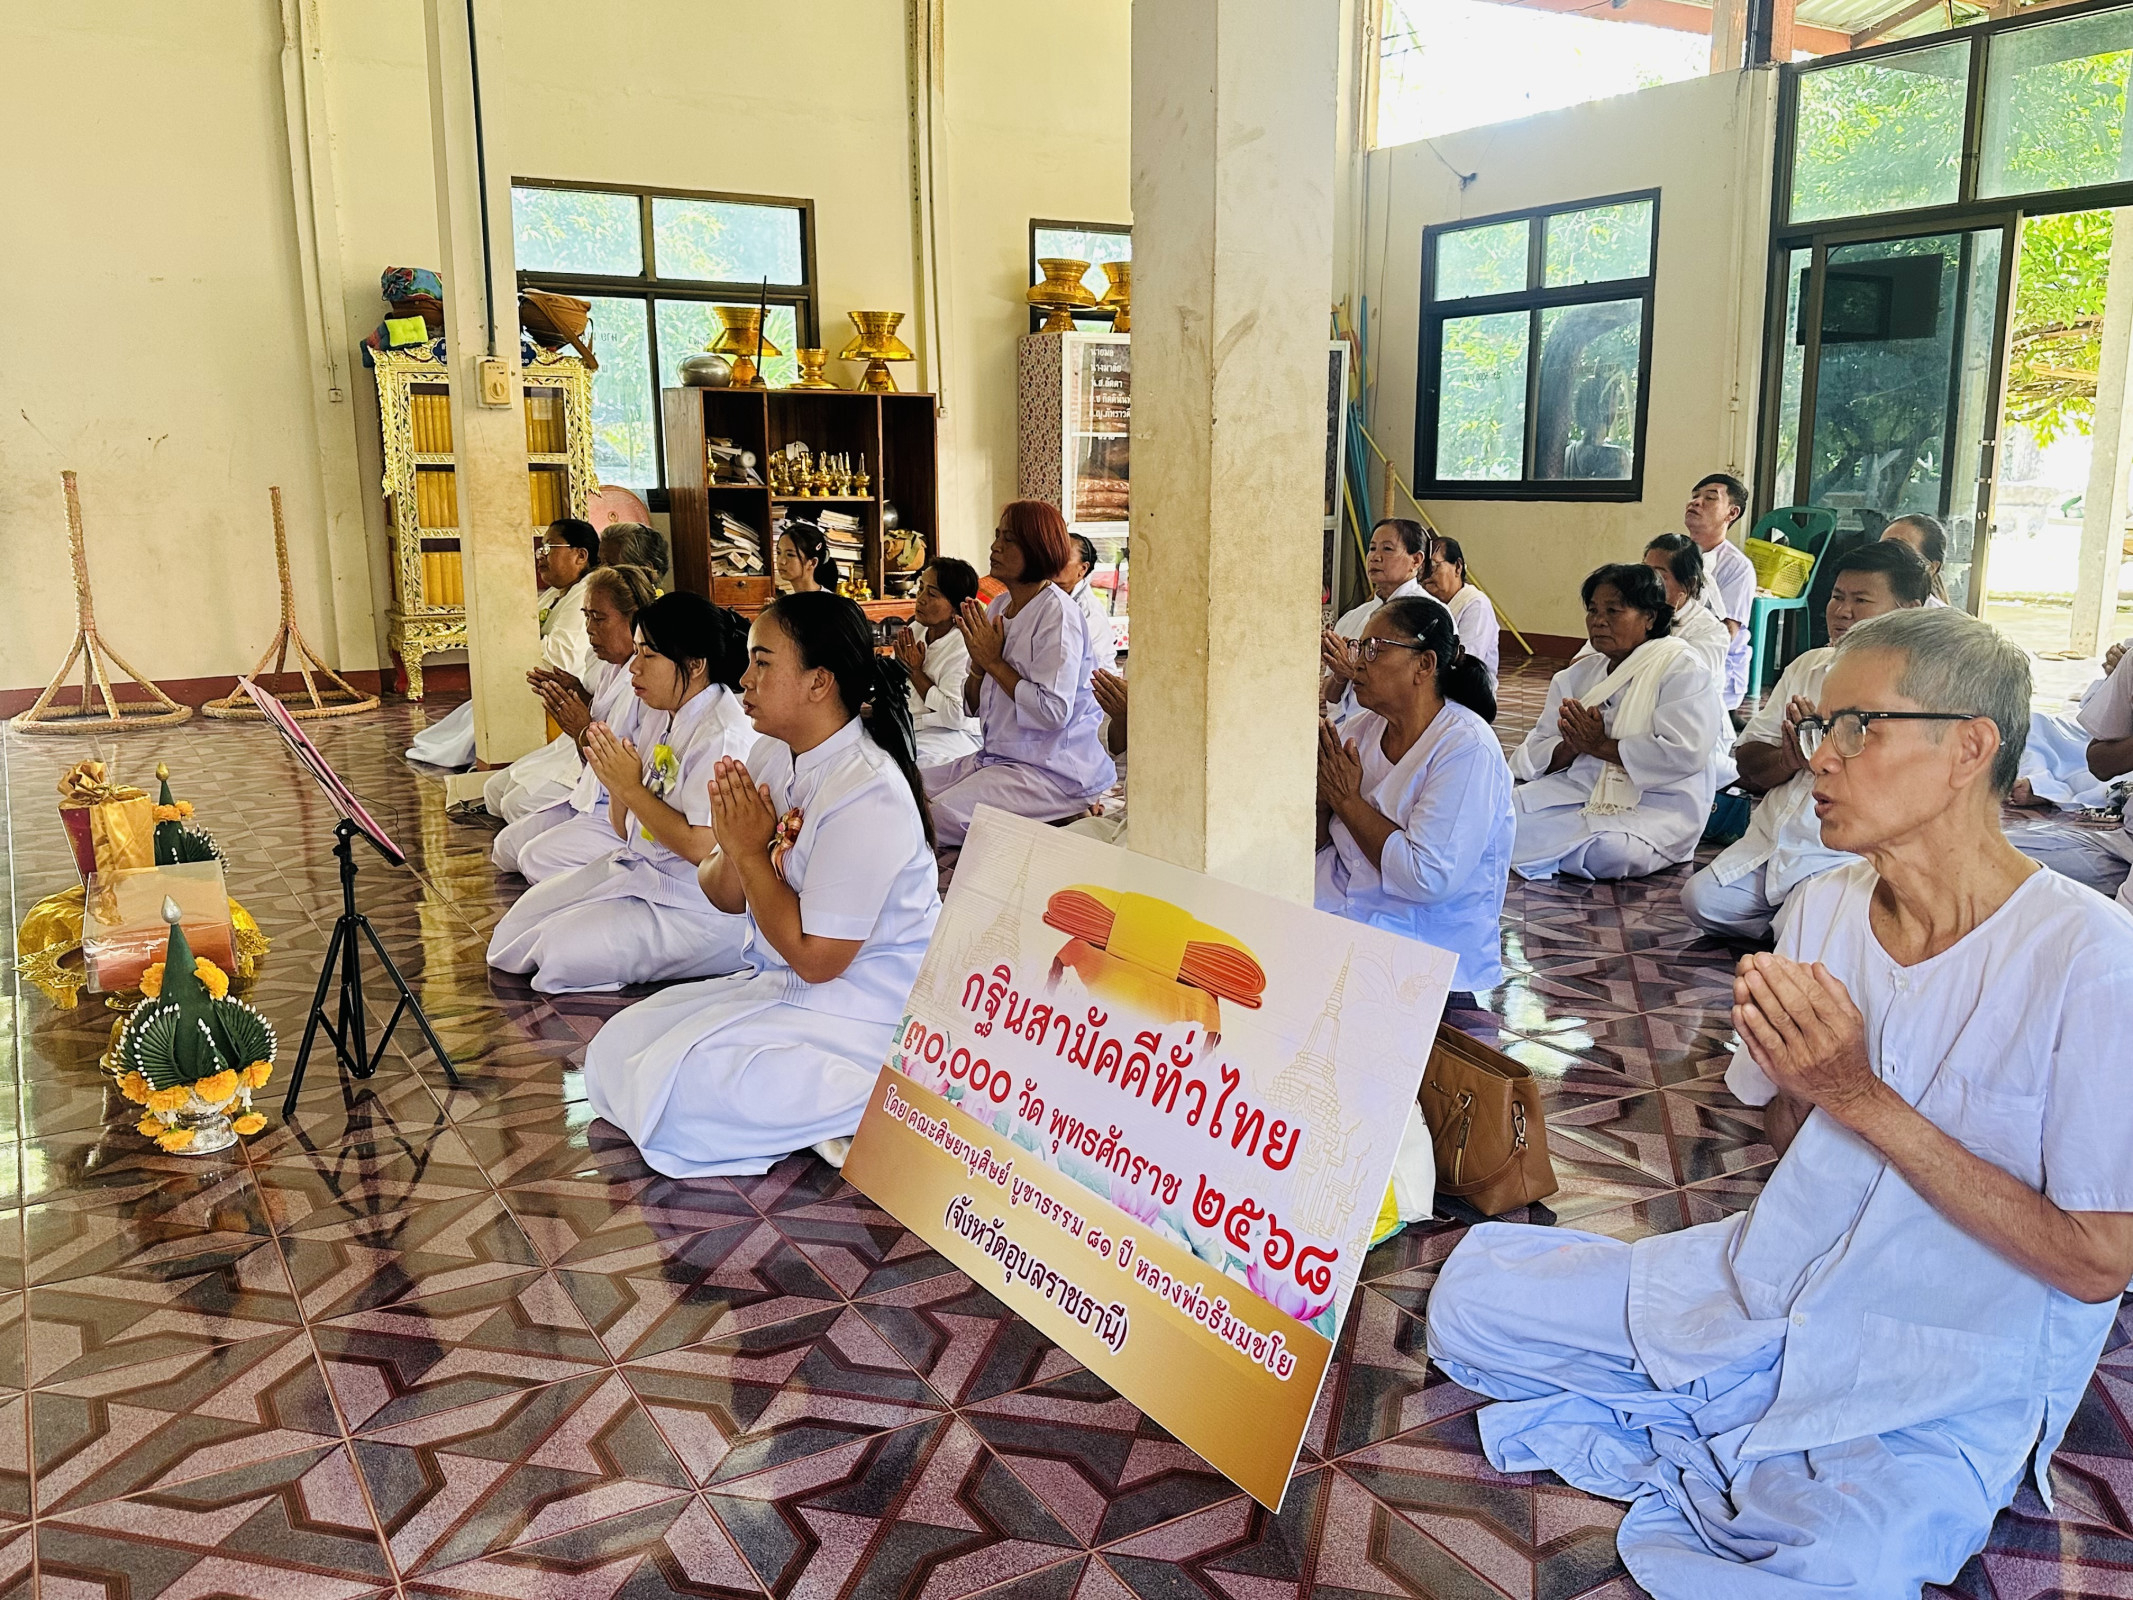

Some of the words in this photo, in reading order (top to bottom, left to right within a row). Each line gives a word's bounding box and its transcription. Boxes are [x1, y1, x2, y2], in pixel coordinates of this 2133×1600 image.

[904, 1020, 1012, 1103] ๓๐,๐๐๐
[1019, 1078, 1045, 1126] วัด
[1050, 1108, 1183, 1205] พุทธศักราช
[1192, 1173, 1339, 1295] ๒๕๖๘
[961, 964, 1301, 1171] กฐินสามัคคีทั่วไทย
[884, 1087, 907, 1119] โดย
[908, 1110, 1013, 1186] คณะศิษยานุศิษย์
[1011, 1177, 1085, 1236] บูชาธรรม
[1087, 1230, 1113, 1257] ๘๑
[1119, 1239, 1133, 1268] ปี
[1137, 1258, 1297, 1377] หลวงพ่อธัมมชโย
[945, 1196, 1130, 1353] (จังหวัดอุบลราชธานี)
